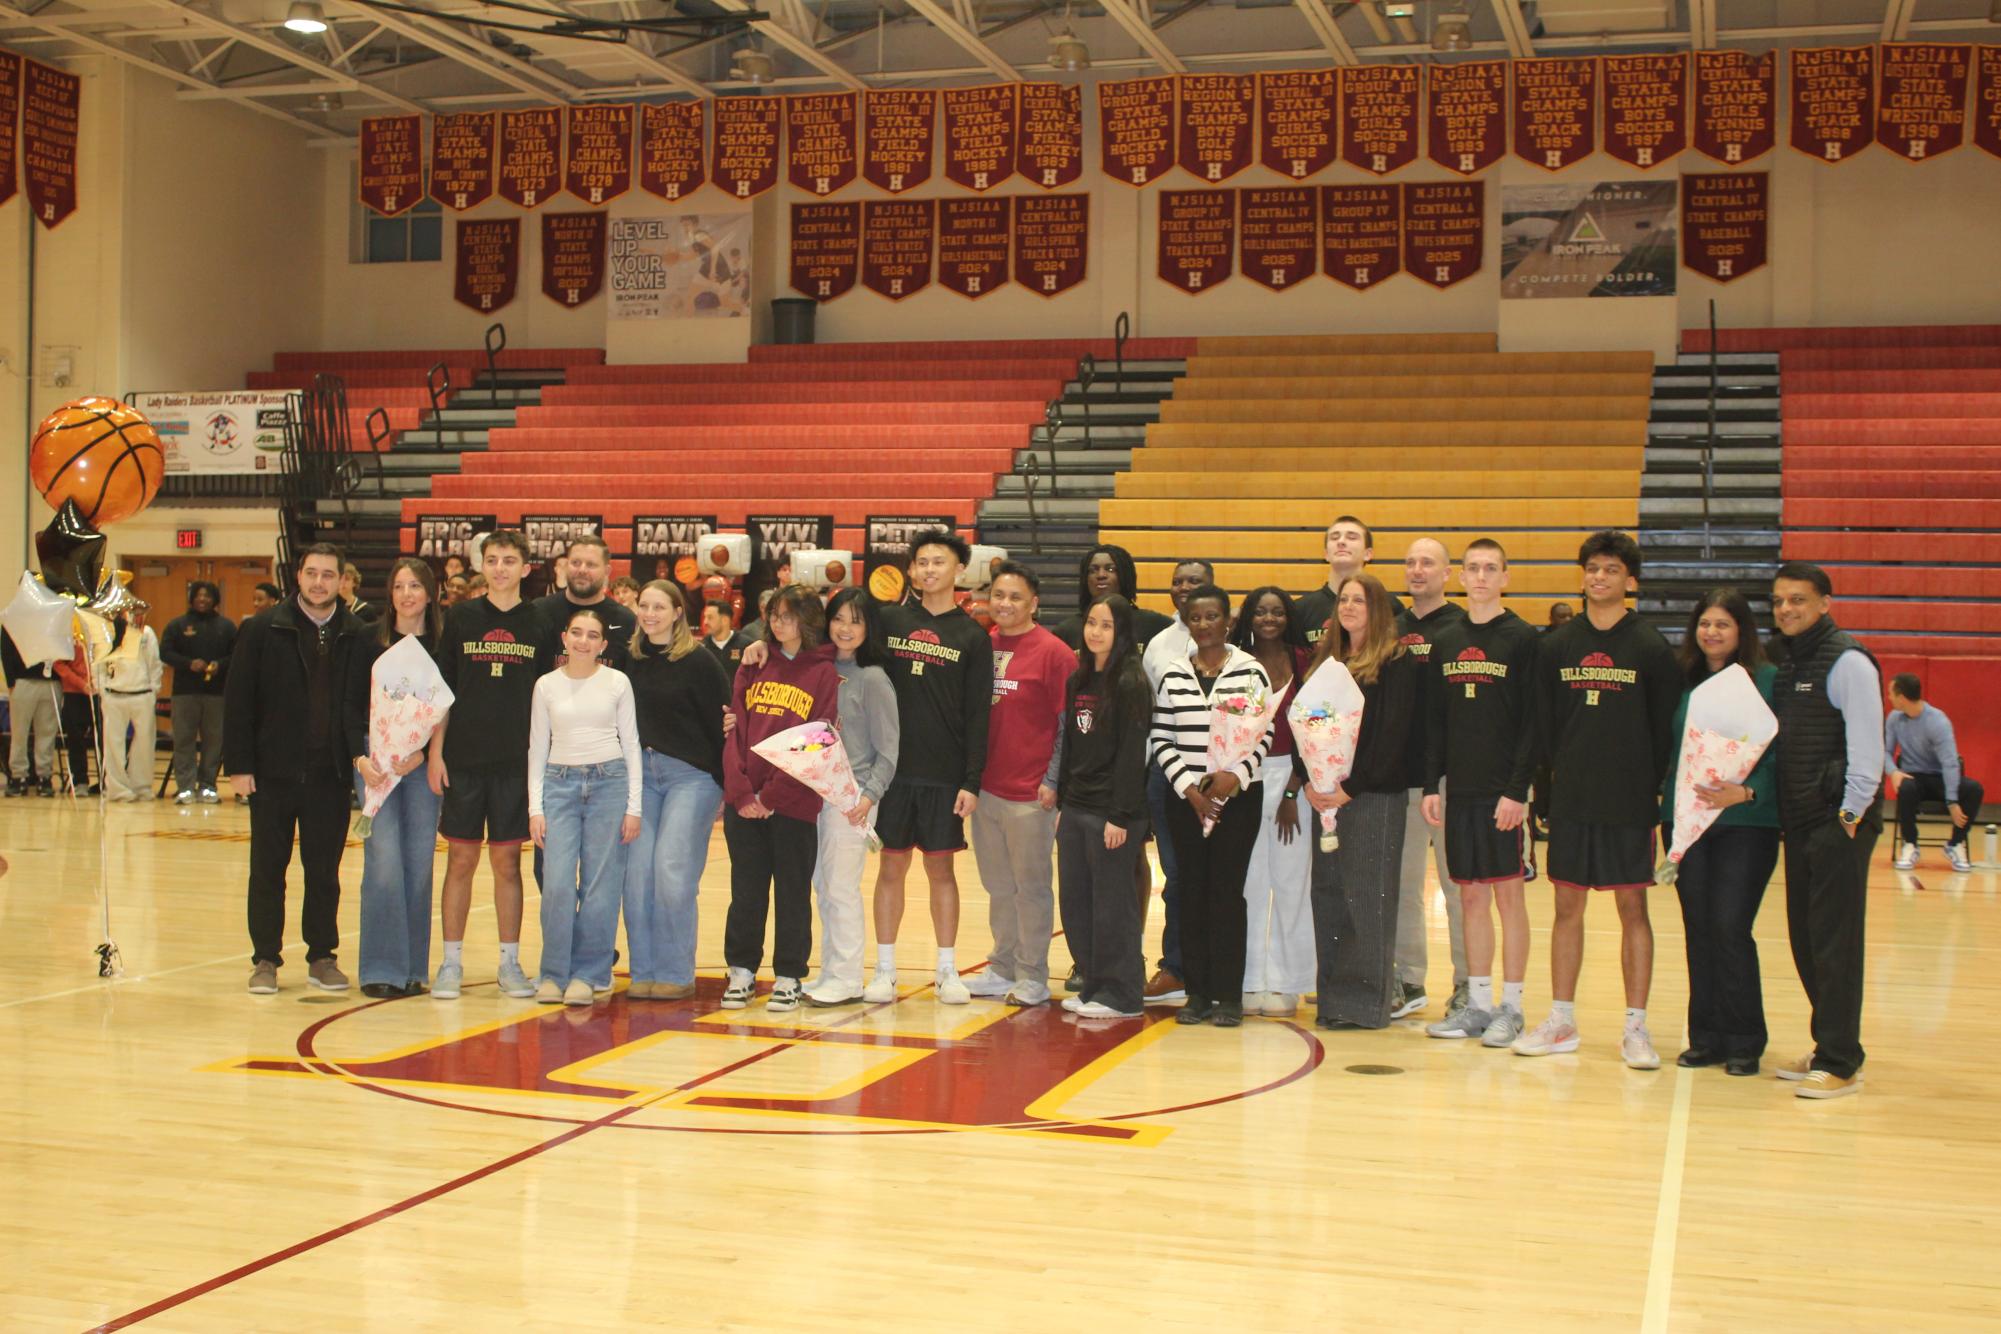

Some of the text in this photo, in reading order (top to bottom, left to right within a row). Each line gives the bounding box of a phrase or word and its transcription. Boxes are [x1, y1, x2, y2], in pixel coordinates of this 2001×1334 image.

[869, 93, 931, 103] NJSIAA
[1103, 95, 1148, 107] GROUP
[1184, 90, 1236, 100] REGION
[1624, 109, 1666, 120] BOYS
[1712, 106, 1759, 117] GIRLS
[1810, 102, 1857, 114] GIRLS
[1447, 116, 1486, 128] BOYS
[1534, 112, 1575, 123] BOYS
[1806, 115, 1861, 127] TRACK
[1881, 109, 1962, 123] WRESTLING
[1109, 116, 1168, 131] CHAMPS
[1277, 122, 1322, 134] GIRLS
[1360, 118, 1402, 129] GIRLS
[1528, 124, 1581, 136] TRACK
[1615, 121, 1674, 134] SOCCER
[1705, 119, 1765, 130] TENNIS
[871, 128, 928, 138] CHAMPS
[1117, 129, 1160, 143] FIELD
[1197, 126, 1236, 137] BOYS
[1354, 130, 1408, 142] SOCCER
[1447, 128, 1486, 140] GOLF
[1717, 131, 1752, 142] 1997
[1900, 125, 1939, 139] 1998
[441, 138, 480, 147] STATE
[515, 139, 547, 151] STATE
[879, 140, 918, 150] FIELD
[960, 135, 1002, 148] FIELD
[1198, 139, 1235, 149] GOLF
[1272, 134, 1327, 147] SOCCER
[1450, 141, 1484, 152] 1993
[1536, 137, 1572, 148] 1995
[1627, 135, 1662, 146] 1997
[726, 147, 766, 157] FIELD
[954, 146, 1008, 160] HOCKEY
[1025, 145, 1079, 156] HOCKEY
[1111, 140, 1167, 155] HOCKEY
[1283, 147, 1316, 158] 1992
[1726, 144, 1741, 160] H
[1825, 142, 1841, 159] H
[1909, 141, 1925, 157] H
[792, 150, 853, 164] FOOTBALL
[871, 152, 925, 161] HOCKEY
[1123, 153, 1155, 166] 1983
[1199, 151, 1232, 161] 1985
[1460, 154, 1474, 170] H
[1546, 151, 1561, 167] H
[1637, 148, 1652, 164] H
[571, 161, 626, 173] SOFTBALL
[648, 161, 699, 172] HOCKEY
[720, 158, 772, 169] HOCKEY
[884, 163, 910, 173] 1981
[965, 160, 997, 172] 1982
[1292, 160, 1306, 176] H
[1373, 155, 1386, 171] H
[808, 164, 839, 177] 1980
[1043, 169, 1057, 184] H
[1133, 167, 1146, 183] H
[1208, 163, 1221, 178] H
[446, 181, 475, 191] 1972
[517, 179, 545, 190] 1973
[816, 178, 829, 193] H
[890, 175, 903, 190] H
[975, 173, 988, 188] H
[667, 183, 679, 198] H
[737, 181, 750, 195] H
[455, 193, 467, 208] H
[523, 191, 535, 205] H
[590, 188, 603, 202] H
[385, 197, 396, 211] H
[44, 204, 54, 220] H
[613, 222, 667, 240] LEVEL
[614, 240, 638, 256] UP
[1553, 244, 1620, 255] IRON PEAK
[1707, 244, 1744, 255] 2025
[1179, 258, 1212, 268] 2024
[1262, 255, 1295, 264] 2025
[1345, 254, 1379, 264] 2025
[1426, 251, 1461, 262] 2025
[612, 256, 661, 272] YOUR
[958, 264, 989, 273] 2024
[1034, 261, 1066, 271] 2024
[1718, 259, 1732, 275] H
[809, 268, 839, 277] 2024
[881, 266, 912, 276] 2024
[1273, 269, 1285, 284] H
[1356, 268, 1368, 283] H
[1436, 267, 1449, 281] H
[613, 272, 665, 289] GAME
[968, 277, 980, 291] H
[1044, 275, 1056, 290] H
[1189, 272, 1202, 287] H
[1520, 274, 1587, 283] COMPETE
[819, 281, 830, 295] H
[891, 280, 902, 294] H
[482, 294, 491, 308] H
[568, 289, 578, 302] H
[147, 397, 161, 408] Lady
[165, 397, 187, 406] Raiders
[190, 396, 222, 405] Basketball
[225, 395, 257, 405] PLATINUM
[421, 522, 472, 539] ERIC
[526, 523, 597, 540] DEREK
[638, 523, 711, 542] DAVID
[760, 524, 818, 541] YUVI
[178, 531, 196, 547] EXIT
[637, 542, 698, 555] BOATEN
[463, 642, 535, 658] HILLSBOROUGH
[888, 636, 960, 662] HILLSBOROUGH
[472, 655, 523, 663] BASKETBALL
[895, 651, 944, 666] BASKETBALL
[491, 663, 503, 676] H
[911, 661, 924, 675] H
[1443, 661, 1507, 677] HILLSBOROUGH
[1560, 667, 1636, 683] HILLSBOROUGH
[1465, 683, 1475, 698] H
[1586, 690, 1600, 705] H
